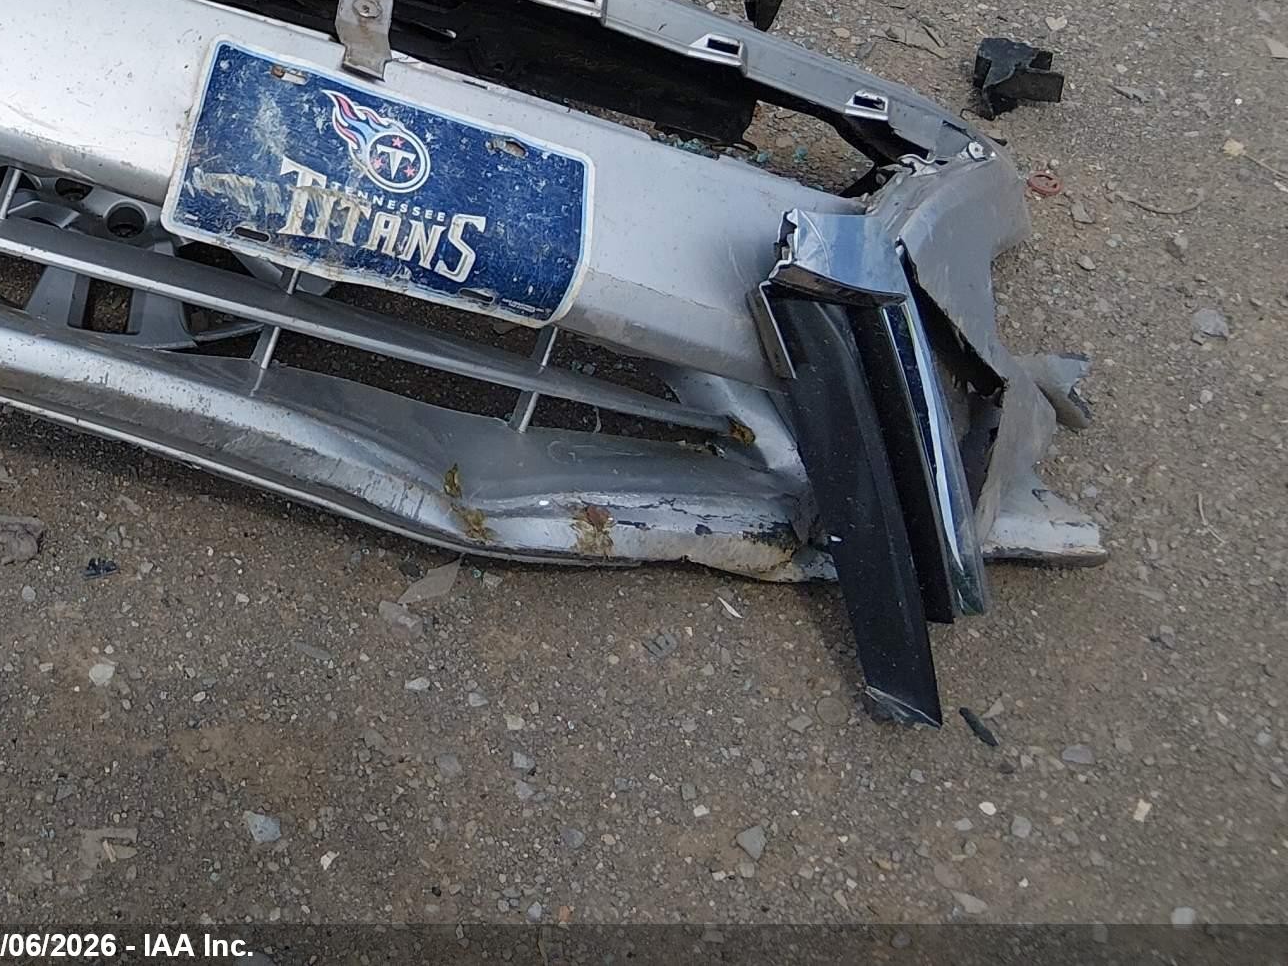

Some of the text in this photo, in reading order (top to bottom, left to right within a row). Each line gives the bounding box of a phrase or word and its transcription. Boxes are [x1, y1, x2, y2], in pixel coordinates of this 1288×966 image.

[376, 144, 417, 180] T
[276, 154, 486, 283] TITANS
[330, 181, 446, 222] TENNESSEE
